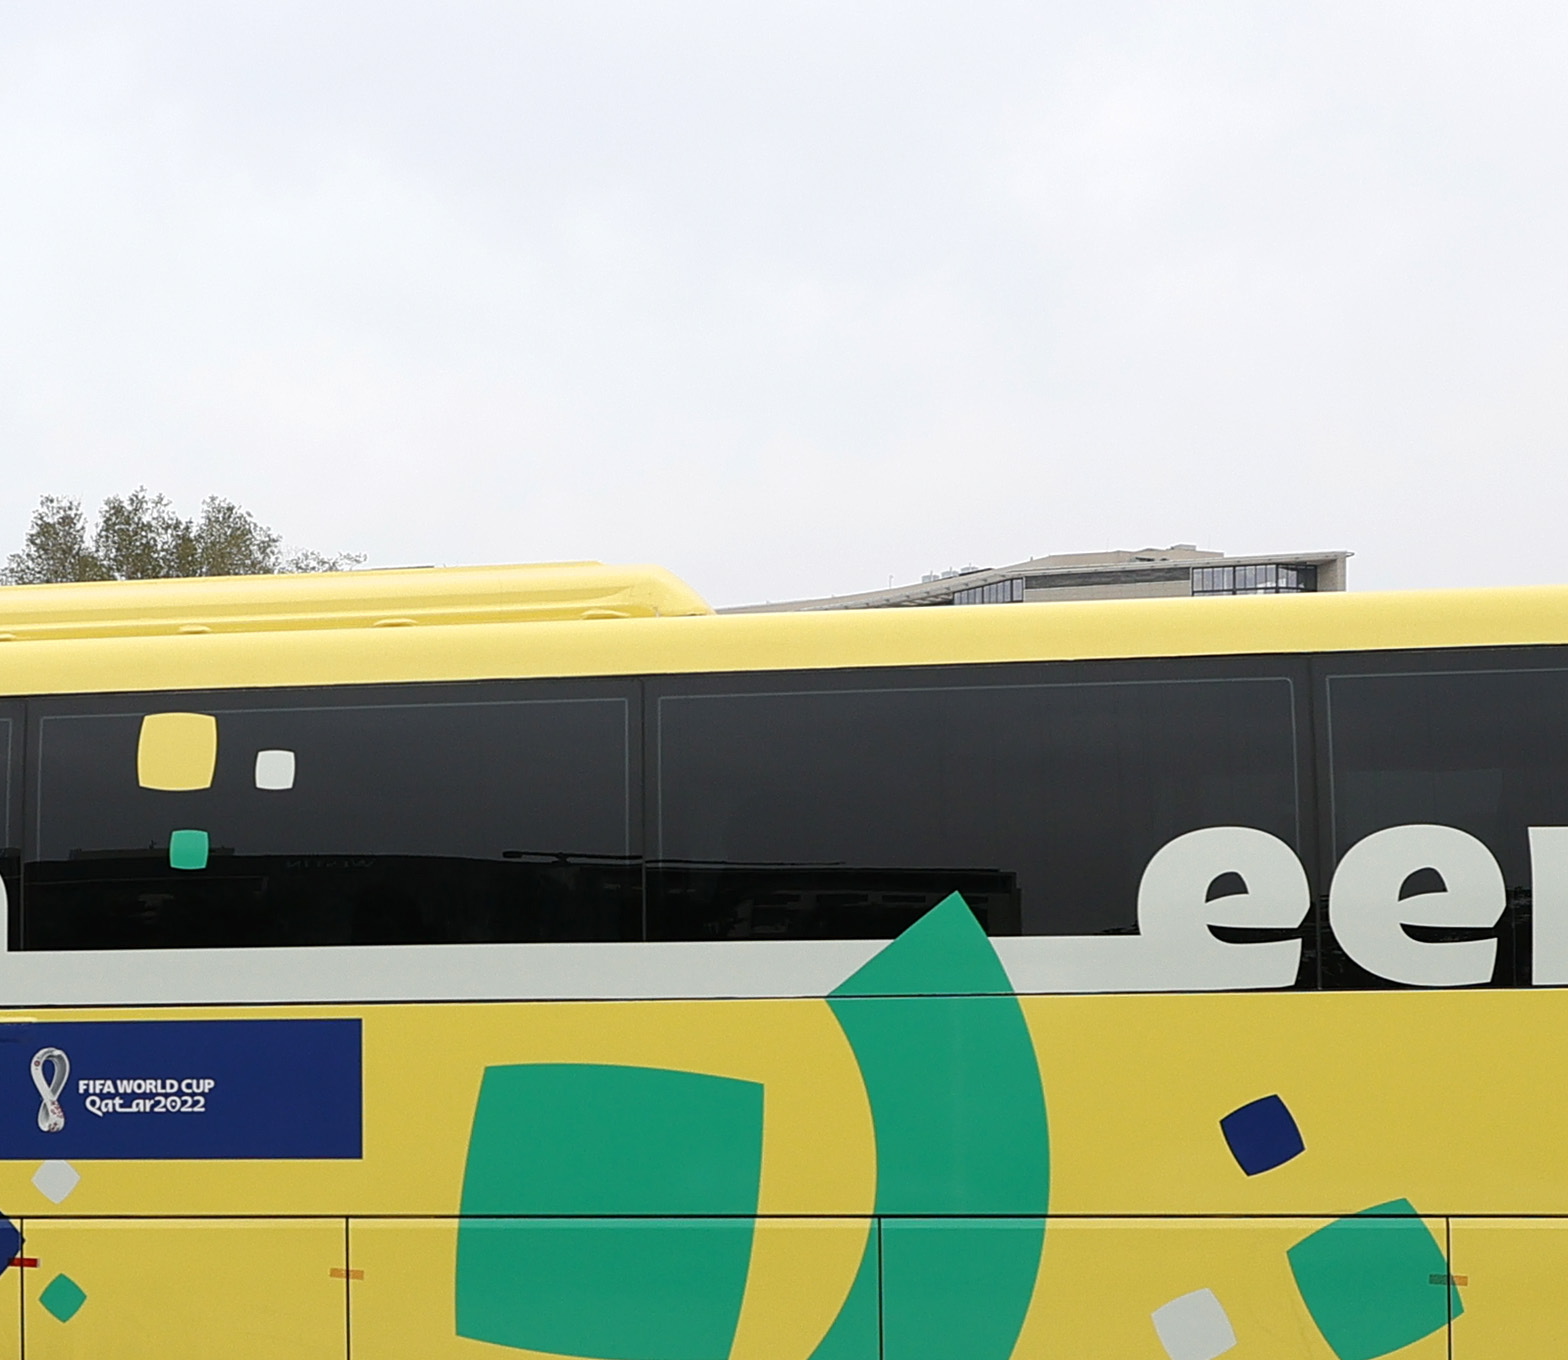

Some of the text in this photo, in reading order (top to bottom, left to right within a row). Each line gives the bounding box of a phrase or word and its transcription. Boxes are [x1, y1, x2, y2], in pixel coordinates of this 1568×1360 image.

[78, 1079, 215, 1094] FIFA WORLD CUP
